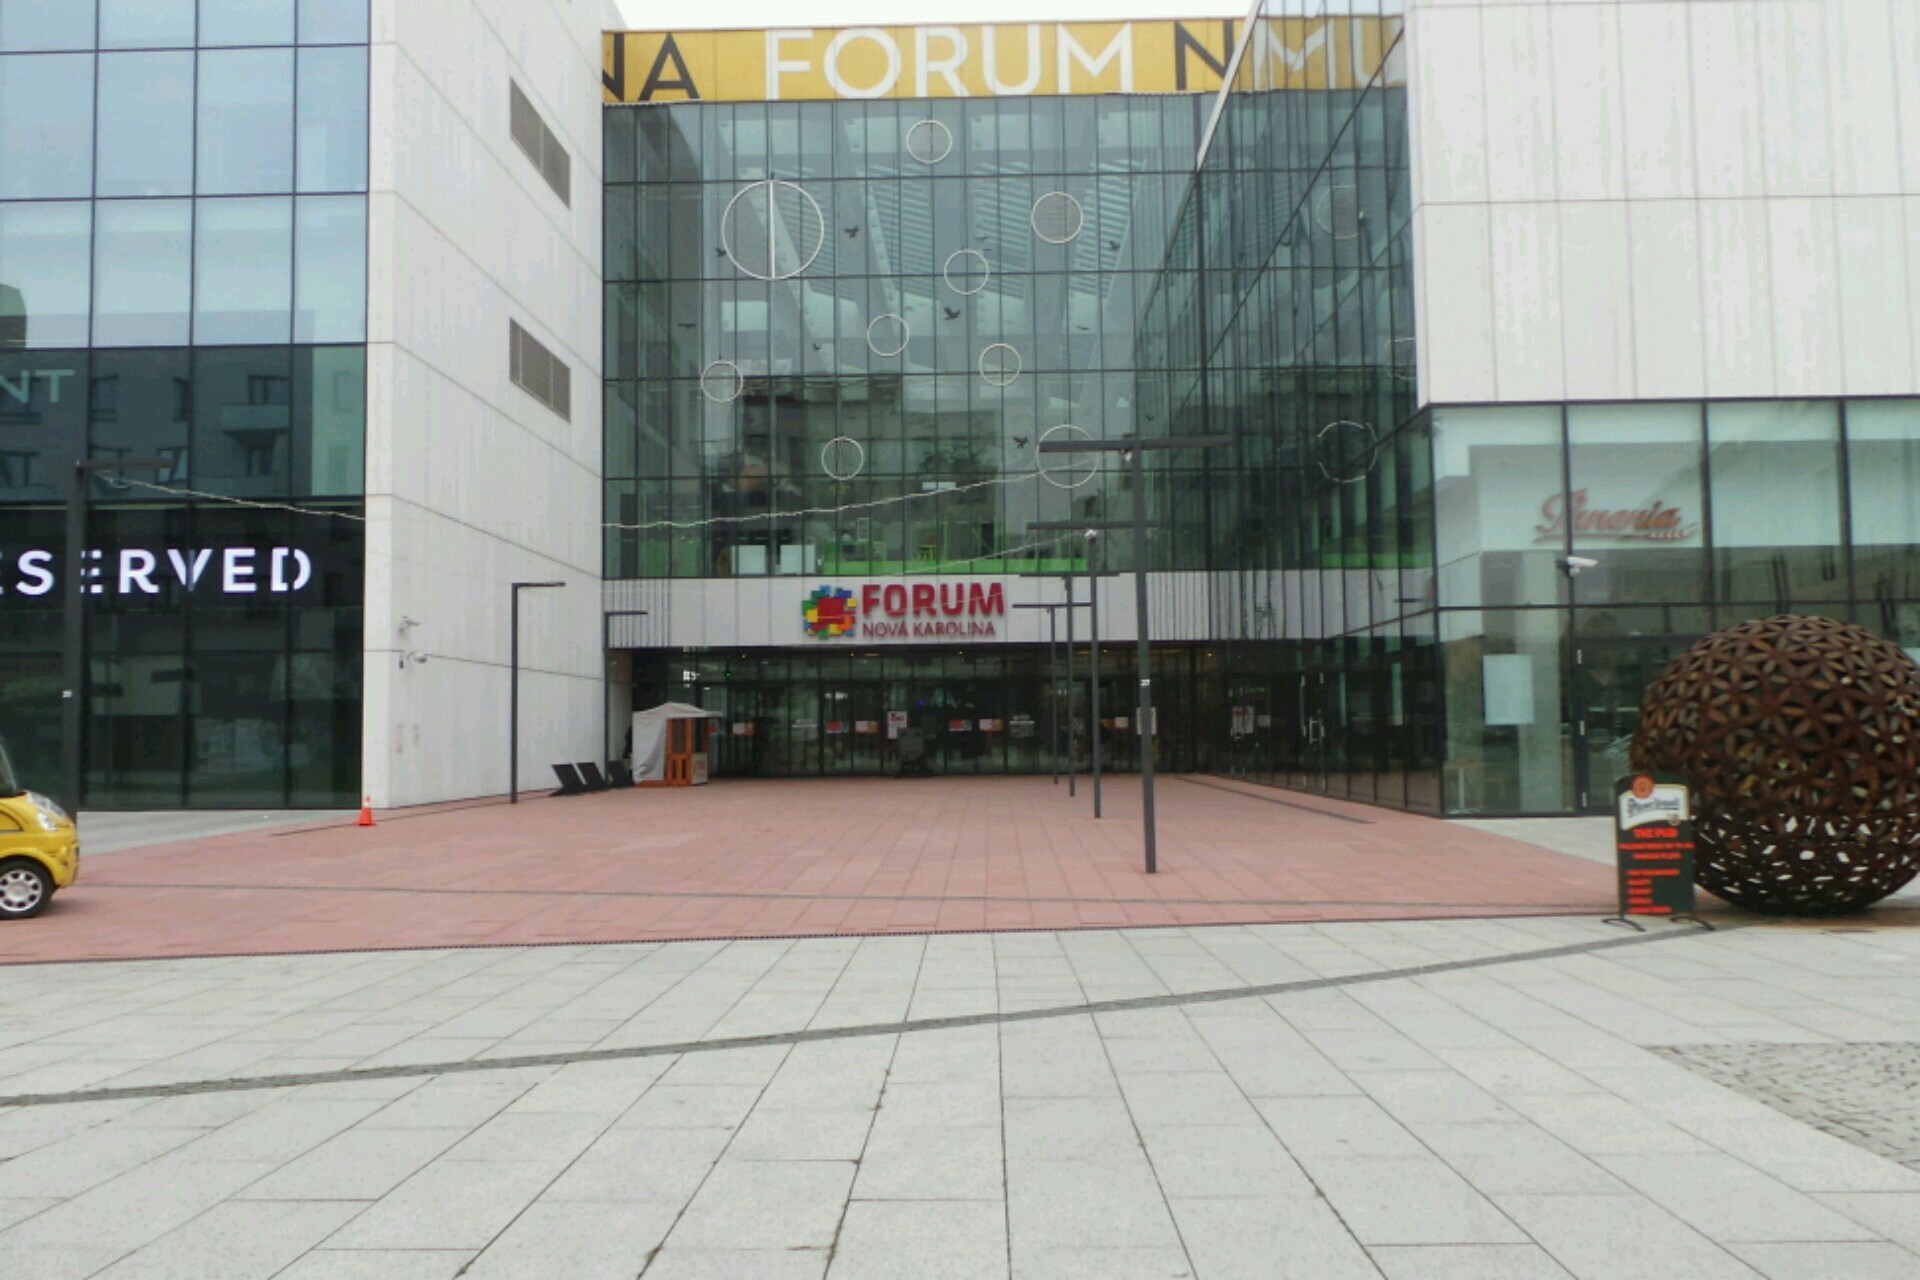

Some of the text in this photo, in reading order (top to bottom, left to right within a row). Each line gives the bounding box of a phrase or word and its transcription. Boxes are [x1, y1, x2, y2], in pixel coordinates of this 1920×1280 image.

[765, 22, 1133, 100] FORUM
[0, 547, 312, 596] SRVED
[861, 582, 1004, 617] FORUM
[862, 620, 996, 637] NOVÁ KAROLINA
